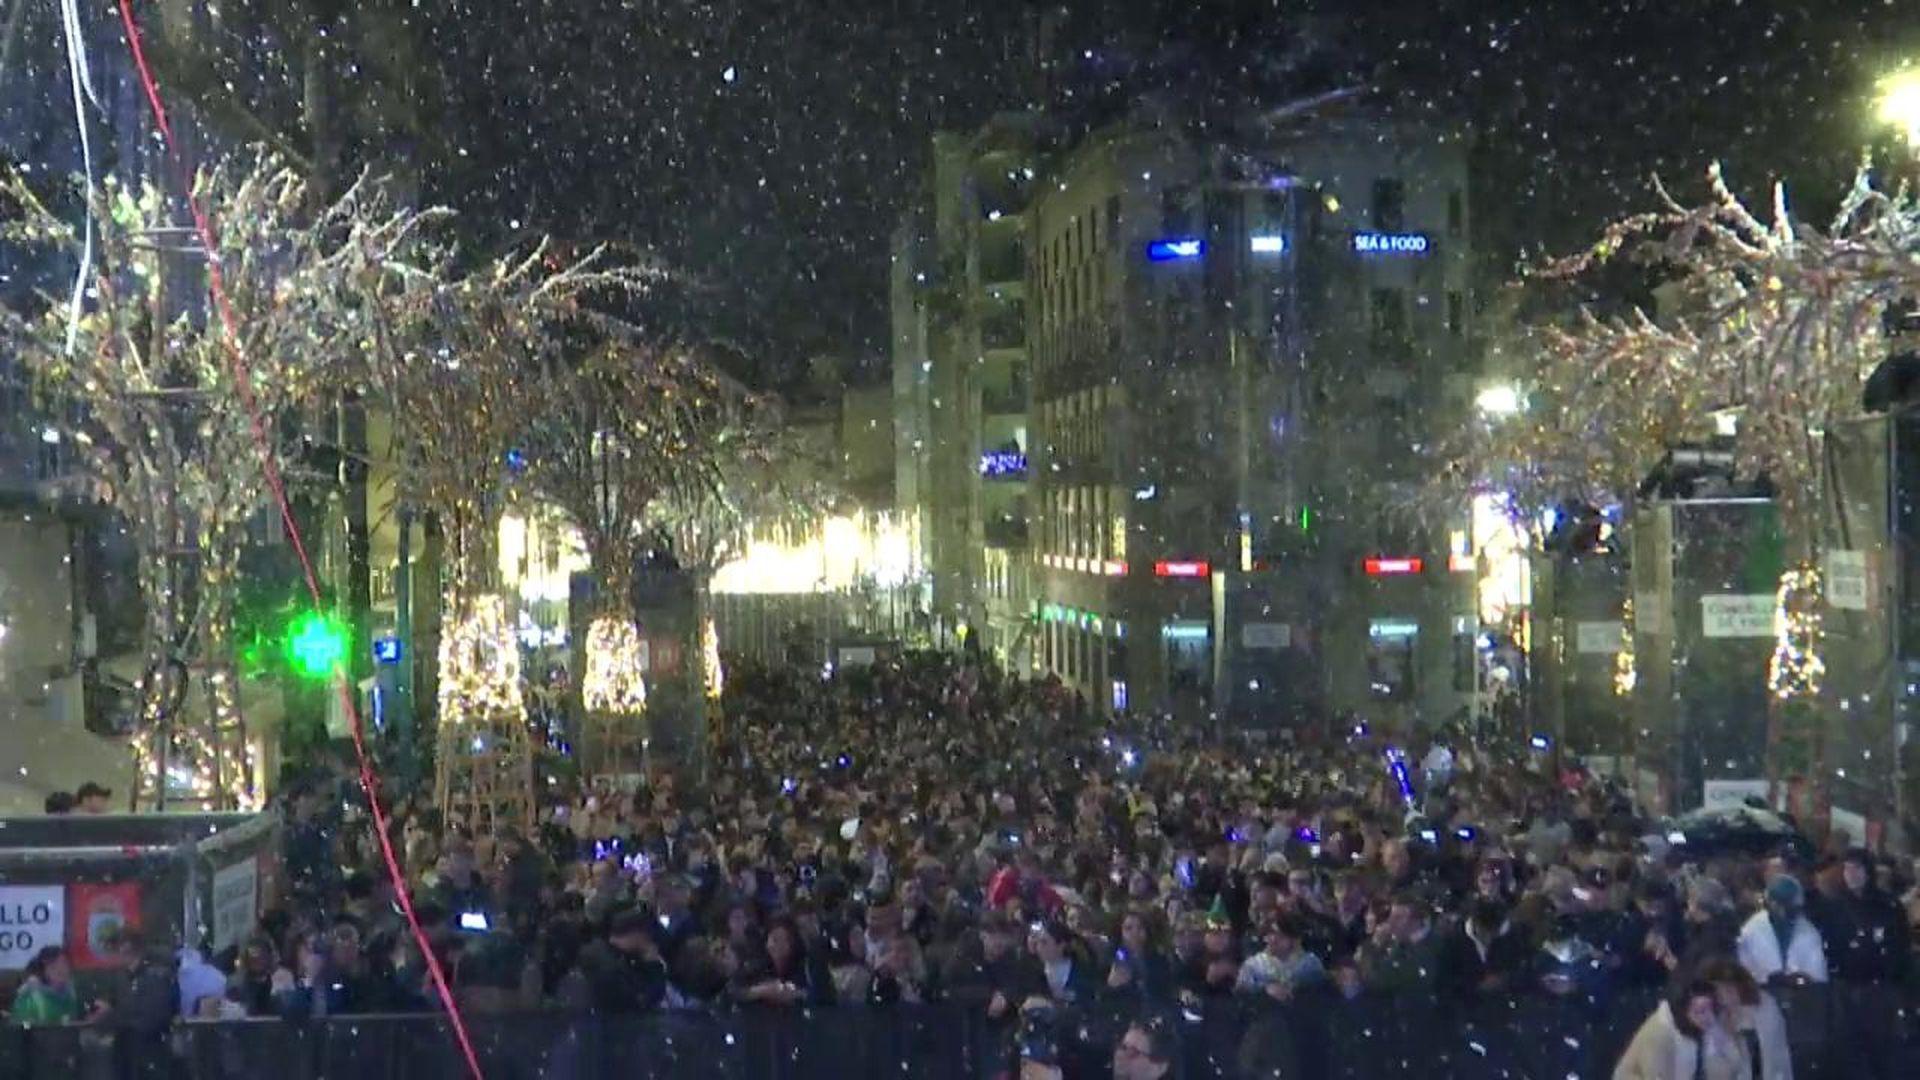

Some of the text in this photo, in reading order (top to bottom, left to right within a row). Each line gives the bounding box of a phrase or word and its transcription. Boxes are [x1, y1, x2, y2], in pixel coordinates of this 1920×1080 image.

[1355, 235, 1378, 251] SEA
[1391, 235, 1426, 251] FOOD
[0, 904, 50, 925] LLO
[0, 930, 34, 951] GO
